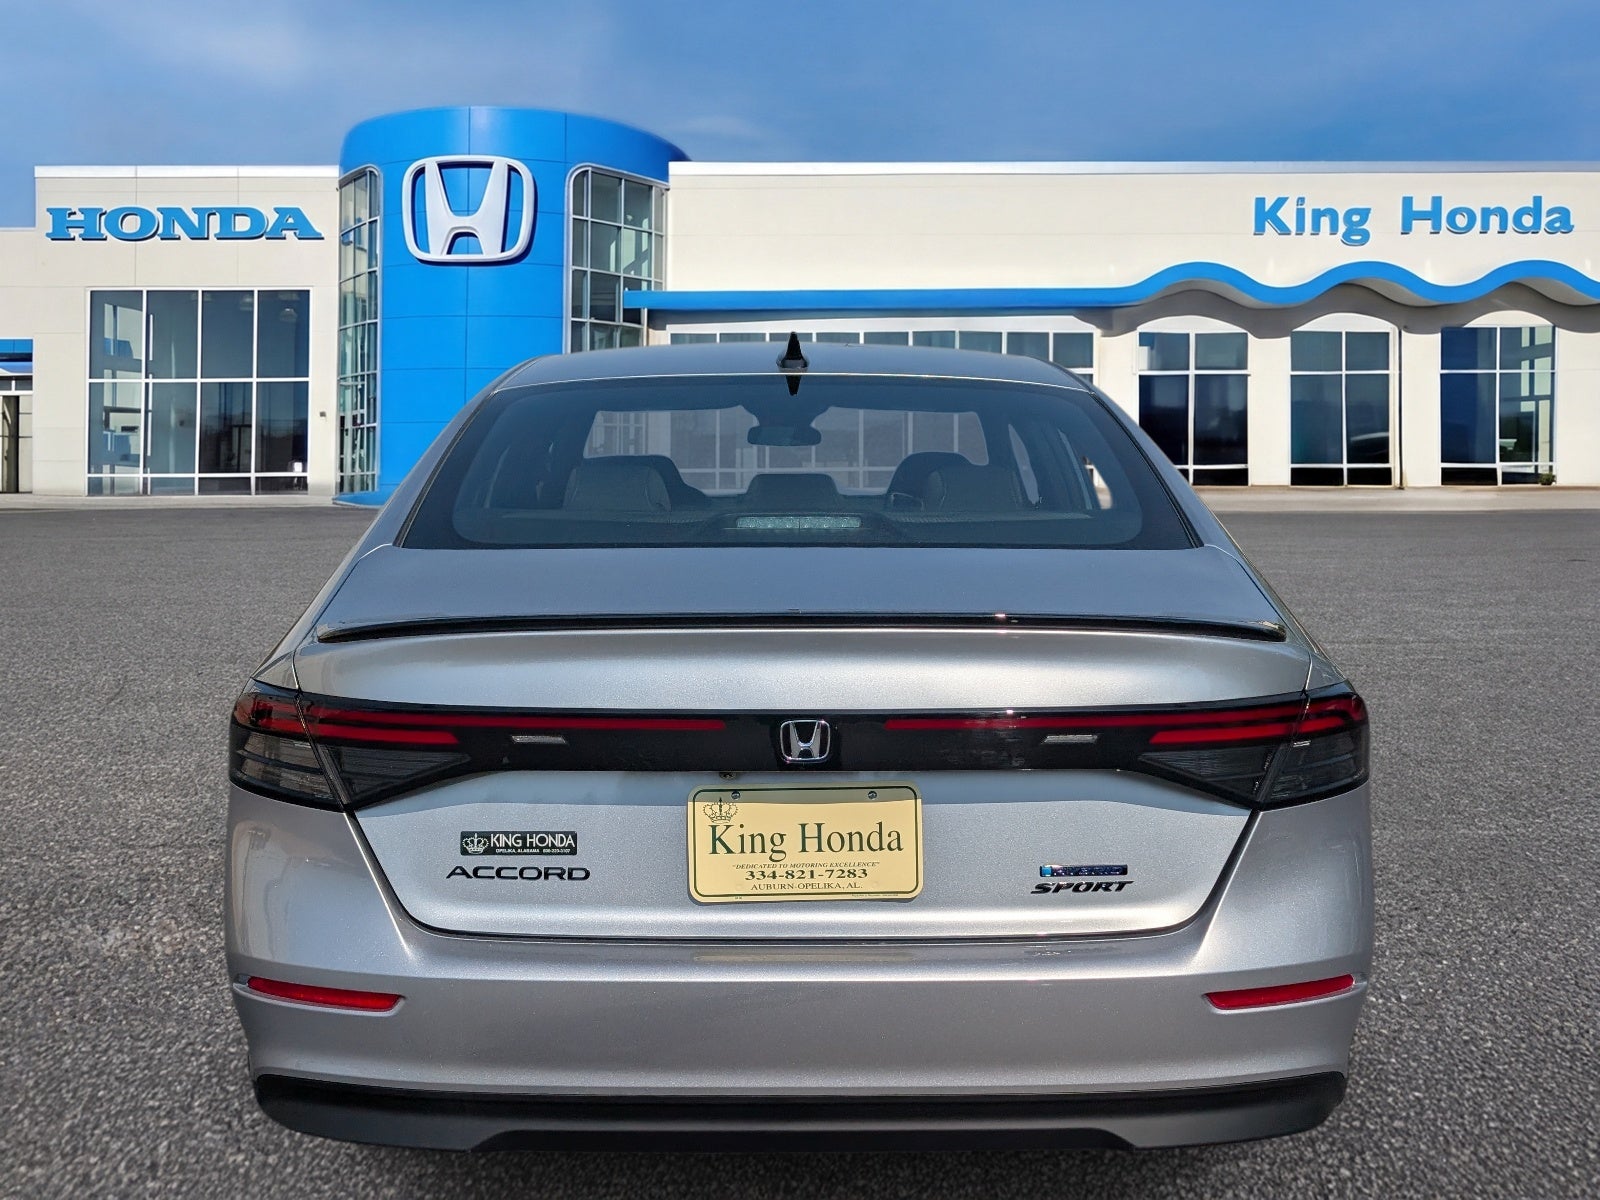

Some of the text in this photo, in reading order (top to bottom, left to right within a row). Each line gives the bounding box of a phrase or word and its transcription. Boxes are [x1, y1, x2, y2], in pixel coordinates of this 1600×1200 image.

[45, 206, 325, 241] HONDA
[1253, 195, 1575, 246] King Honda
[490, 833, 576, 848] KING HONDA
[708, 821, 904, 863] King Honda
[446, 865, 591, 881] ACCORD
[744, 868, 869, 882] 334-821-7283
[846, 882, 864, 891] AL.
[1030, 880, 1135, 894] SPORT
